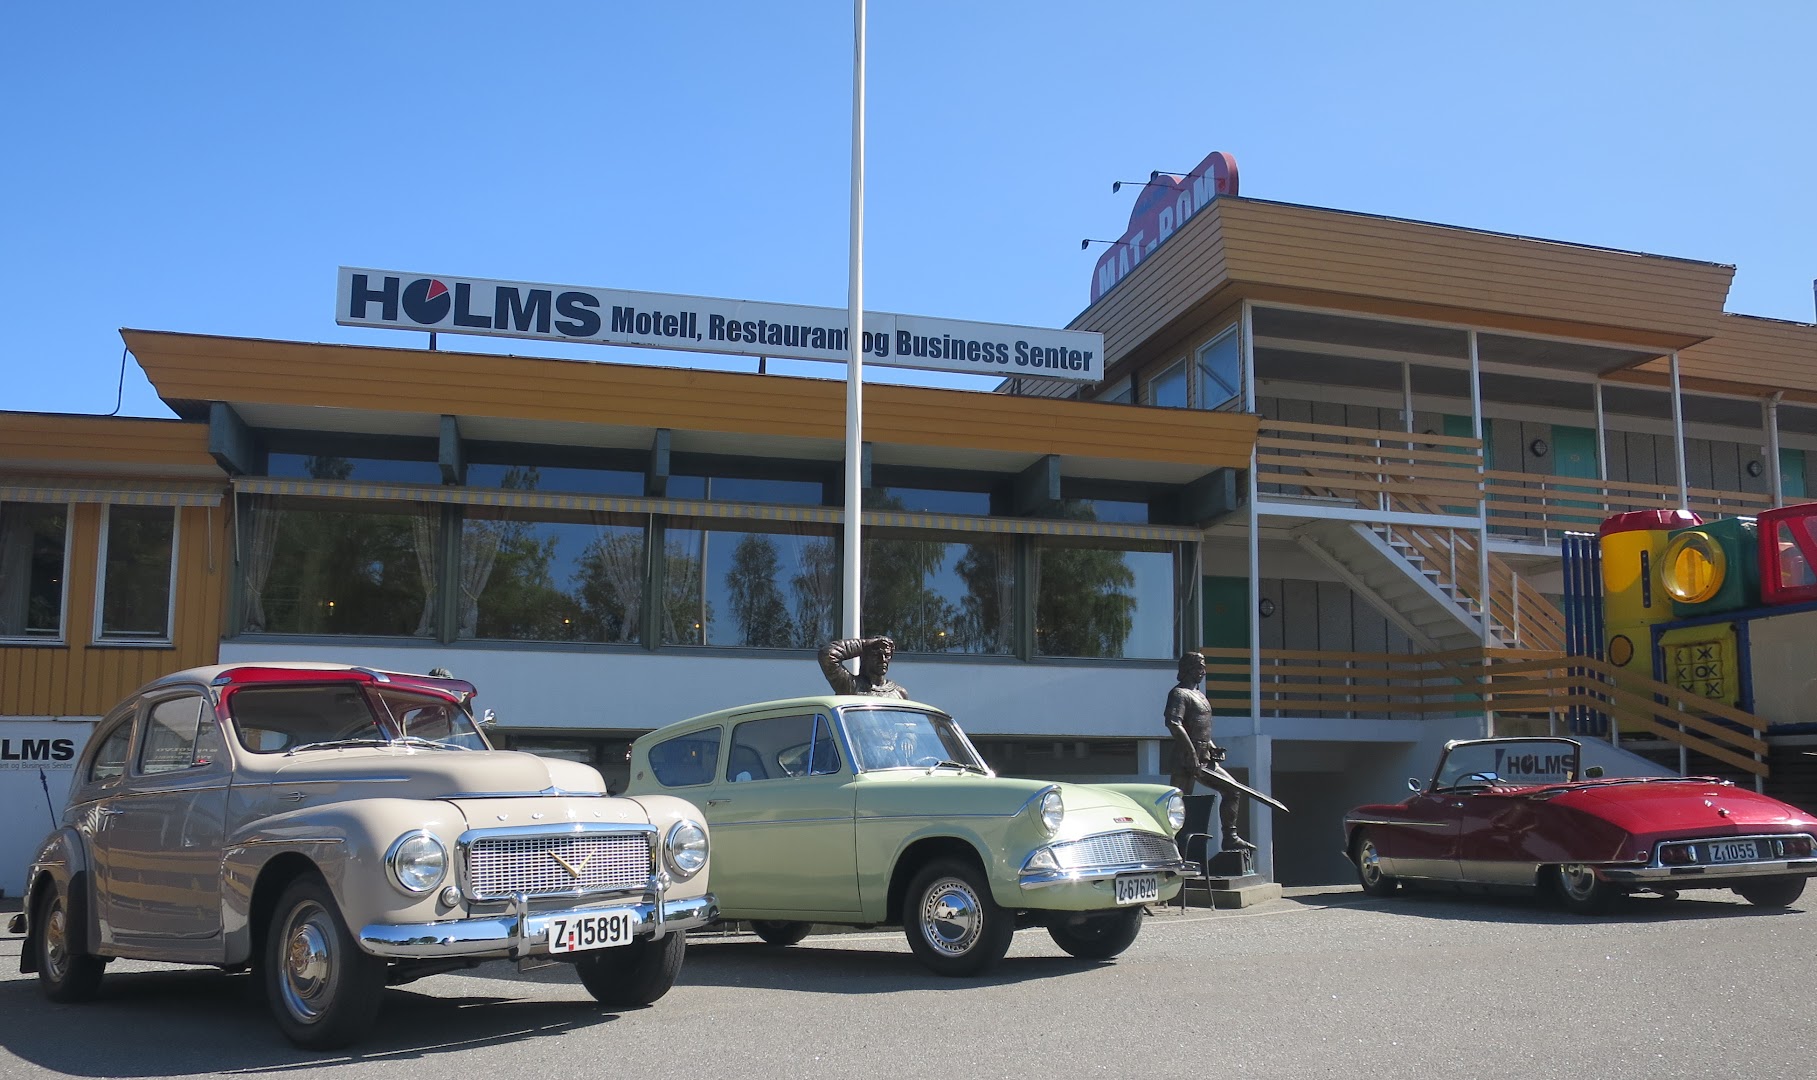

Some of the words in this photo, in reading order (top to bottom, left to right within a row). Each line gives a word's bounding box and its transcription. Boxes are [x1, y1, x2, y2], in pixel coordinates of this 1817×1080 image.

[350, 274, 601, 337] HOLMS
[611, 305, 702, 341] Motell,
[708, 313, 849, 352] Restaurant
[862, 331, 889, 357] og
[897, 330, 1009, 364] Business
[1015, 341, 1093, 371] Senter
[1507, 754, 1575, 775] HOLMS
